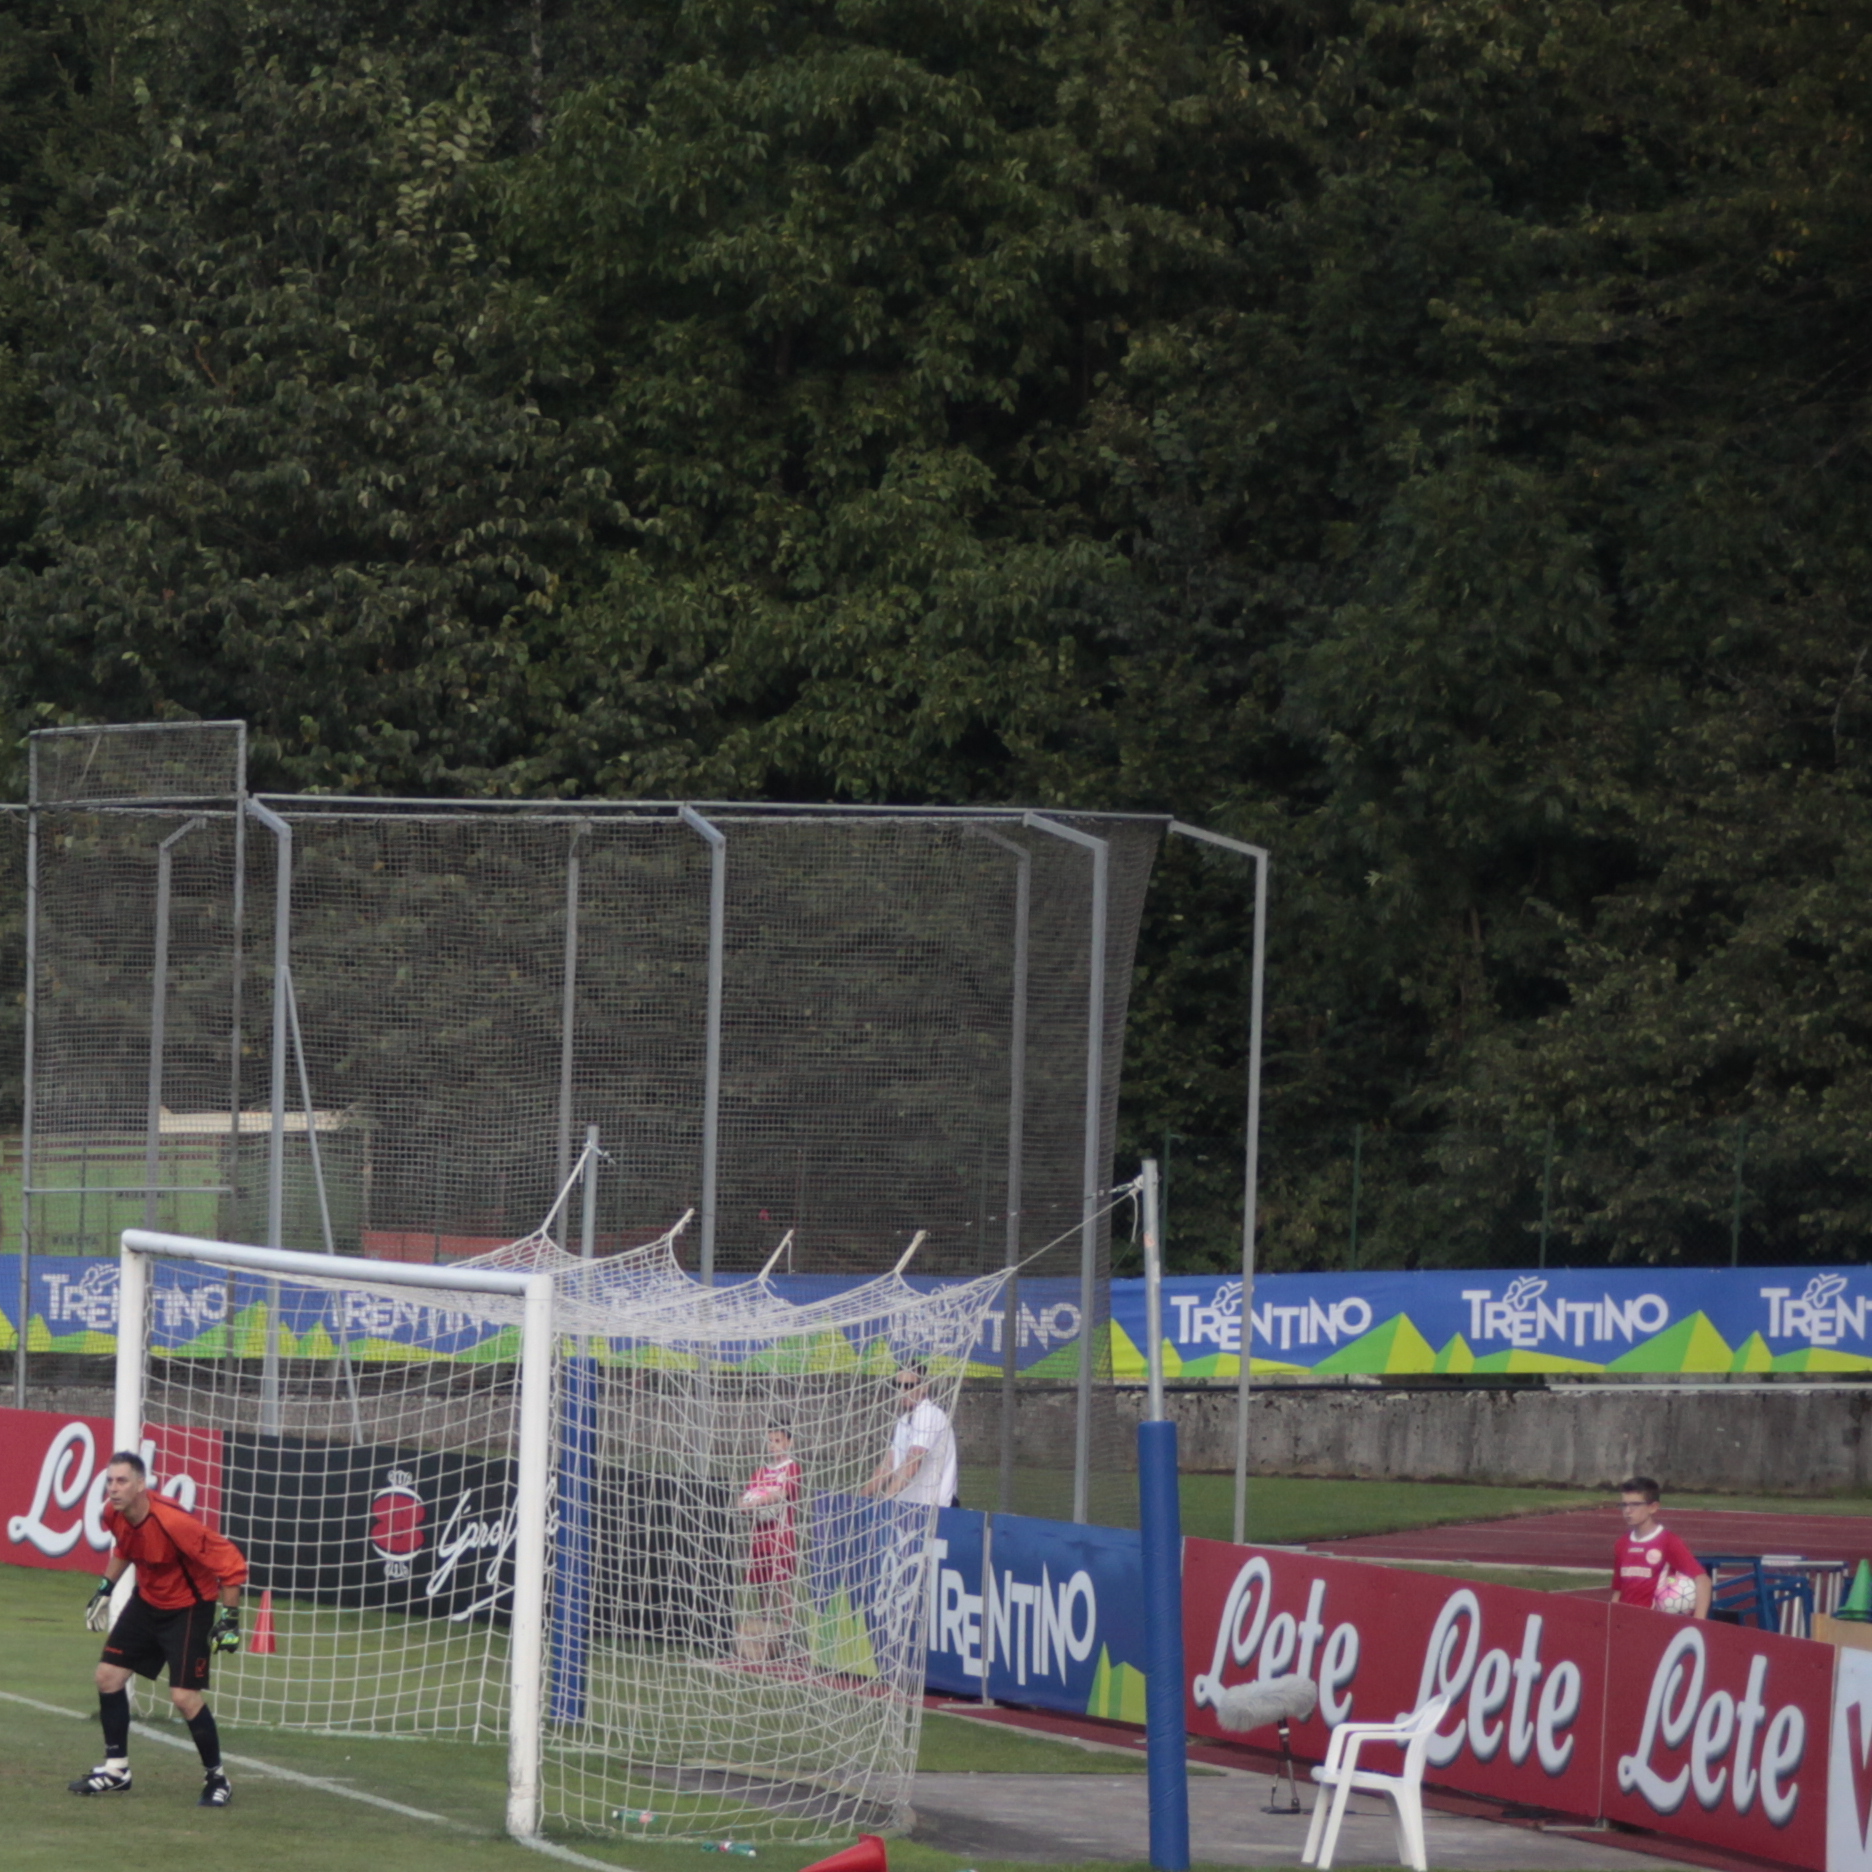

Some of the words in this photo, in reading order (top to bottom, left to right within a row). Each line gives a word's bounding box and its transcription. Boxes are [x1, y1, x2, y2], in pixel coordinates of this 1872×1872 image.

[1170, 1295, 1372, 1351] TRENTINO
[1462, 1289, 1669, 1347] TRENTINO
[925, 1537, 1097, 1687] TRENTINO
[1394, 1588, 1581, 1774] Lete
[1617, 1626, 1805, 1825] Lete
